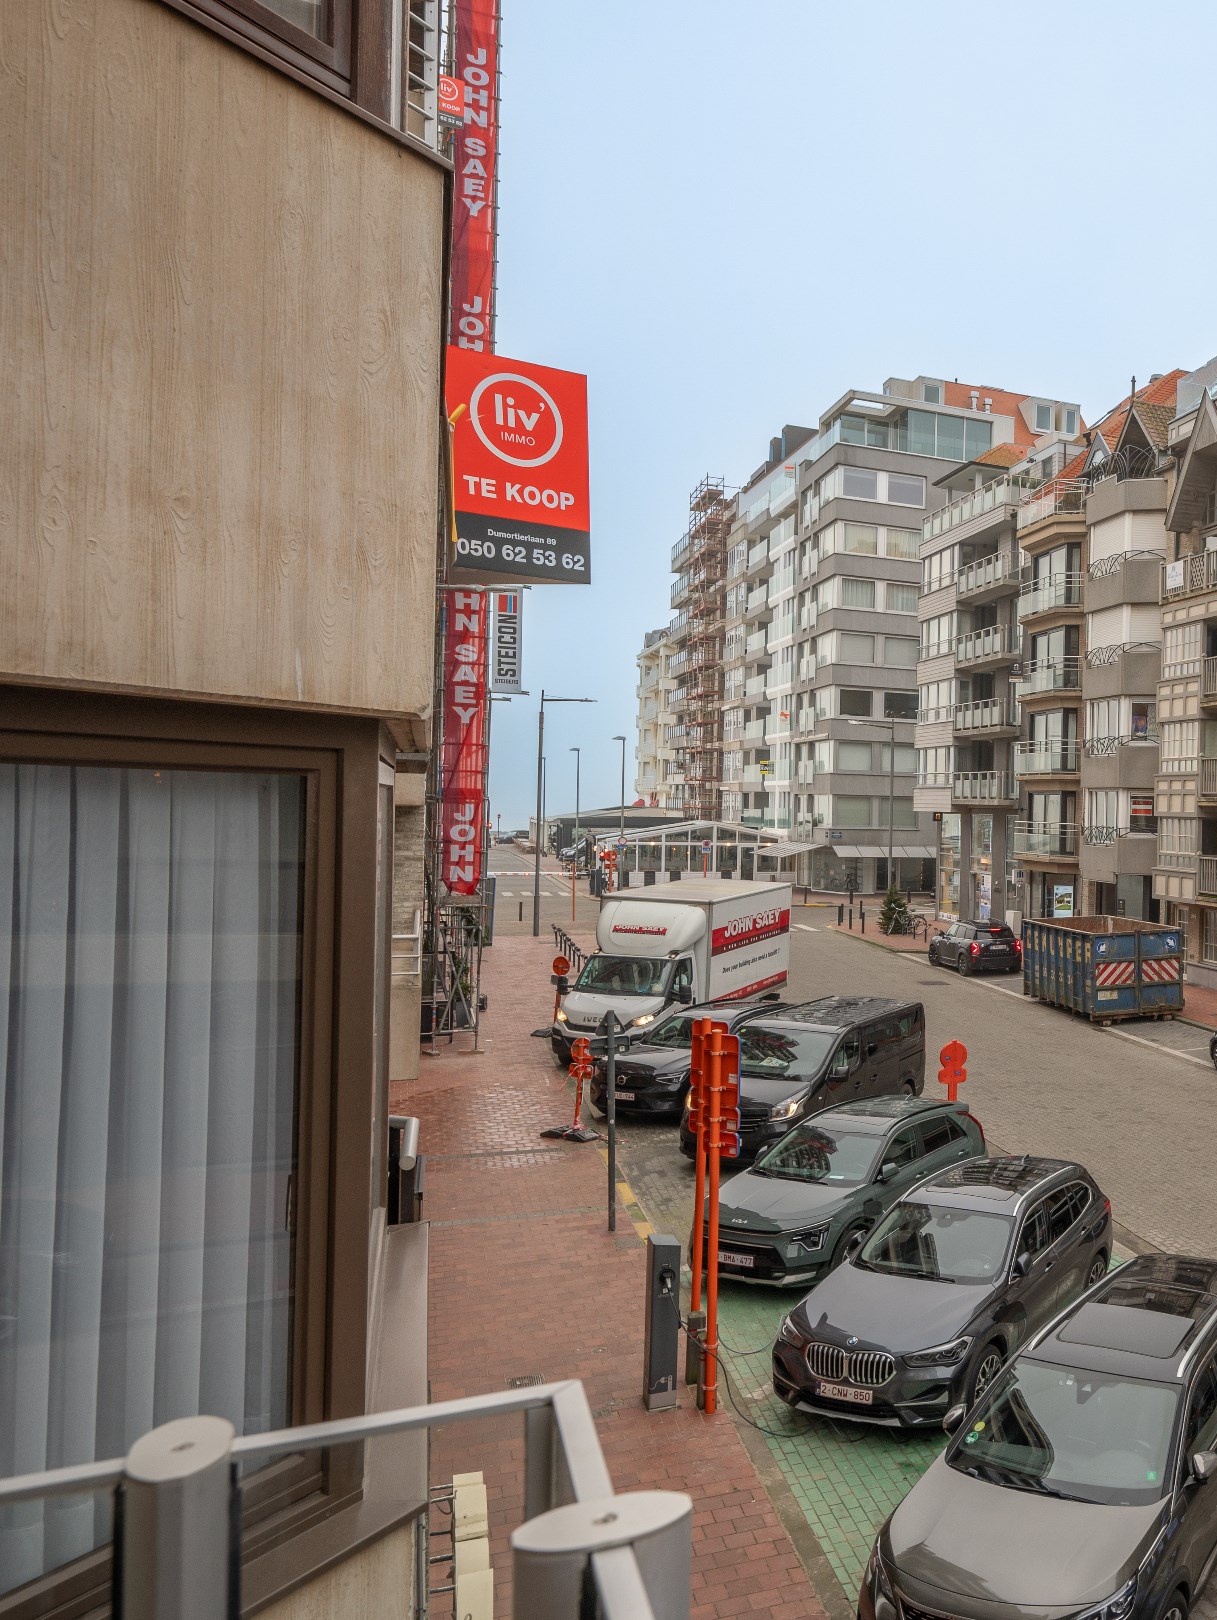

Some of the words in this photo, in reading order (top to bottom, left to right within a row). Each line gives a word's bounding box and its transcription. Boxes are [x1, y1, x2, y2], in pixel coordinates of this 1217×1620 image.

[442, 102, 460, 112] KOOP
[464, 48, 490, 128] JOHN
[462, 137, 488, 217] SAEY
[458, 296, 485, 353] JOH
[494, 393, 545, 431] liv'
[501, 432, 536, 446] IMMO
[463, 475, 496, 498] TE
[506, 482, 575, 510] KOOP
[457, 538, 496, 559] 050
[502, 544, 526, 563] 62
[532, 549, 557, 566] 53
[562, 553, 585, 571] 62
[488, 528, 544, 544] Dumortierlaan
[547, 537, 556, 546] 89
[454, 592, 480, 632] HN
[498, 613, 518, 678] STEICON
[452, 644, 478, 724] SAEY
[450, 803, 475, 882] JOHN
[724, 915, 753, 938] JOHN
[755, 907, 781, 929] SAEY
[822, 1384, 871, 1402] 2-CNW-850
